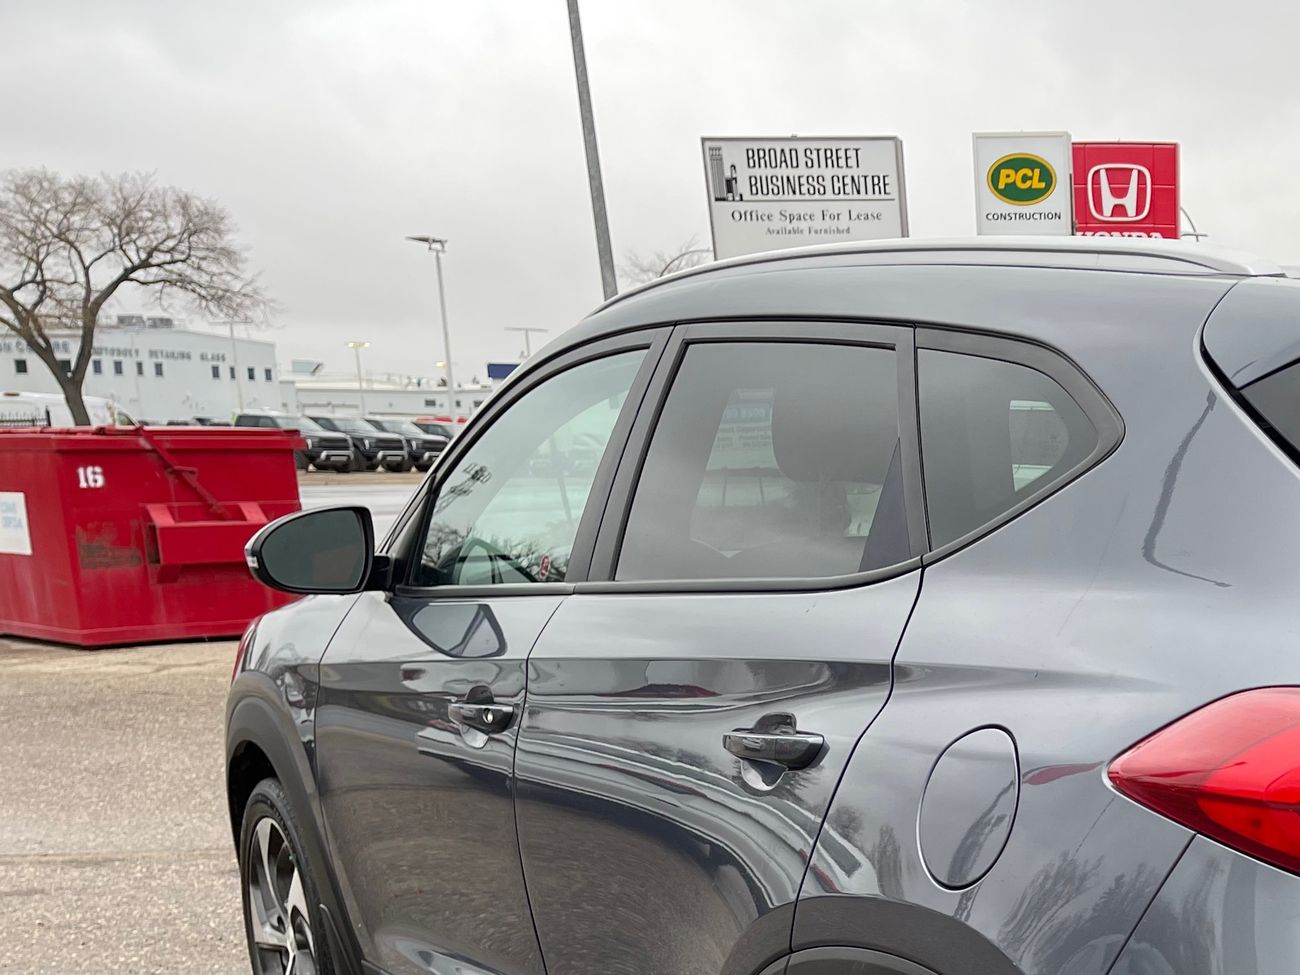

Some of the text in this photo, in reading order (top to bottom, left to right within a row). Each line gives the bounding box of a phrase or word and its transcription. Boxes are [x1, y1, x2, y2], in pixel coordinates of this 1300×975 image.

[746, 148, 861, 169] BROAD STREET
[749, 174, 891, 196] BUSINESS CENTRE
[998, 168, 1046, 190] PCL
[731, 209, 882, 225] Office Space For Lease
[985, 212, 1062, 222] CONSTRUCTION
[765, 226, 851, 235] Available Furnished
[77, 466, 105, 489] 16
